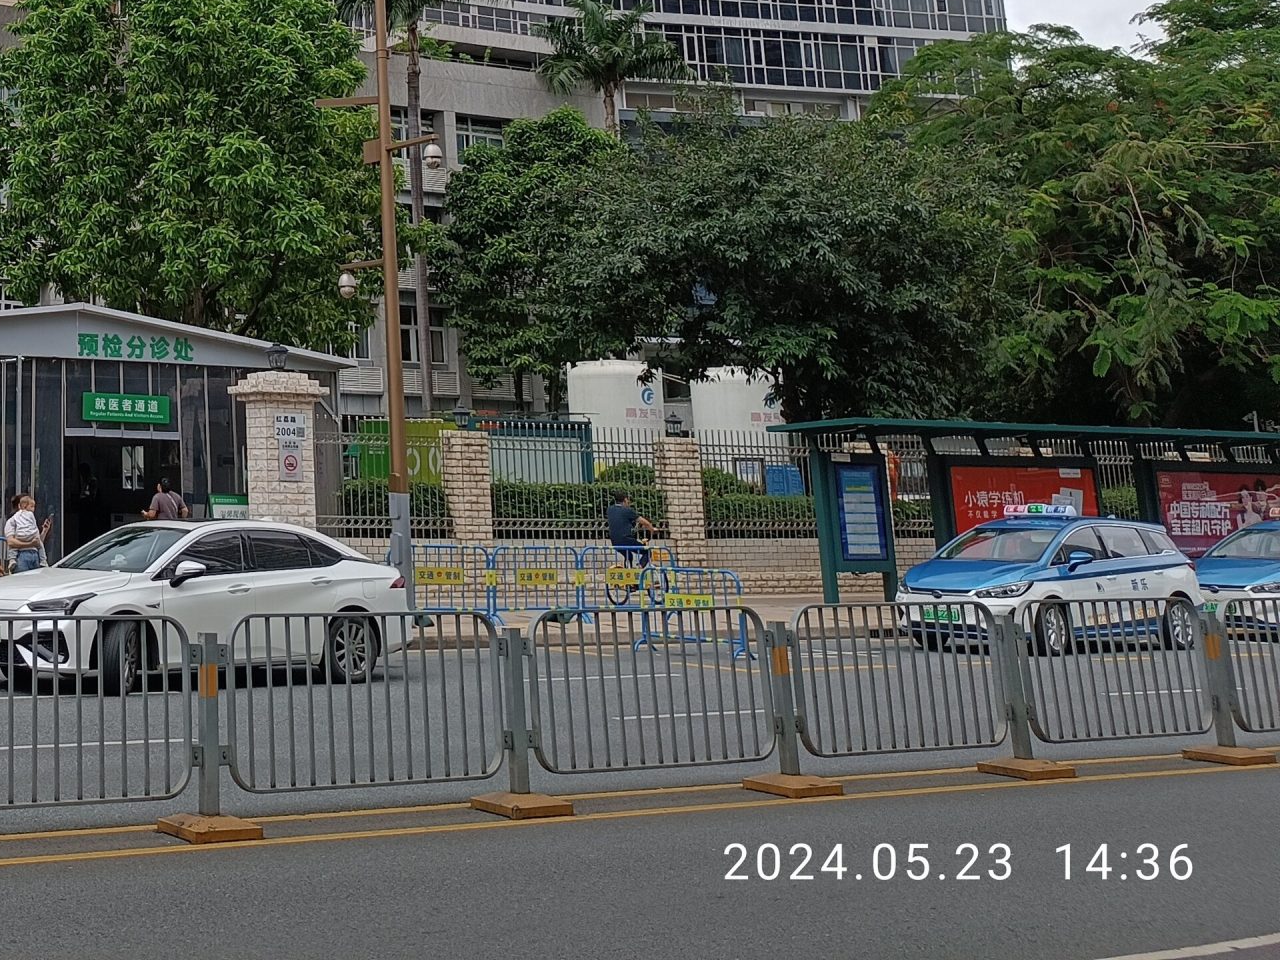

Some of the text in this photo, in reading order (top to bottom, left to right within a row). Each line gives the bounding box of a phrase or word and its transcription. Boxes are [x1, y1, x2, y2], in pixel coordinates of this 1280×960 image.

[77, 332, 194, 362] 预检分诊处
[94, 397, 159, 413] 就医者通道
[276, 427, 296, 436] 2004
[1169, 500, 1231, 519] 中国专利配方
[1170, 519, 1232, 536] 宝宝超凡守护
[419, 570, 460, 581] 交通 管制
[520, 572, 555, 581] 交通 管制
[669, 598, 683, 608] 交通
